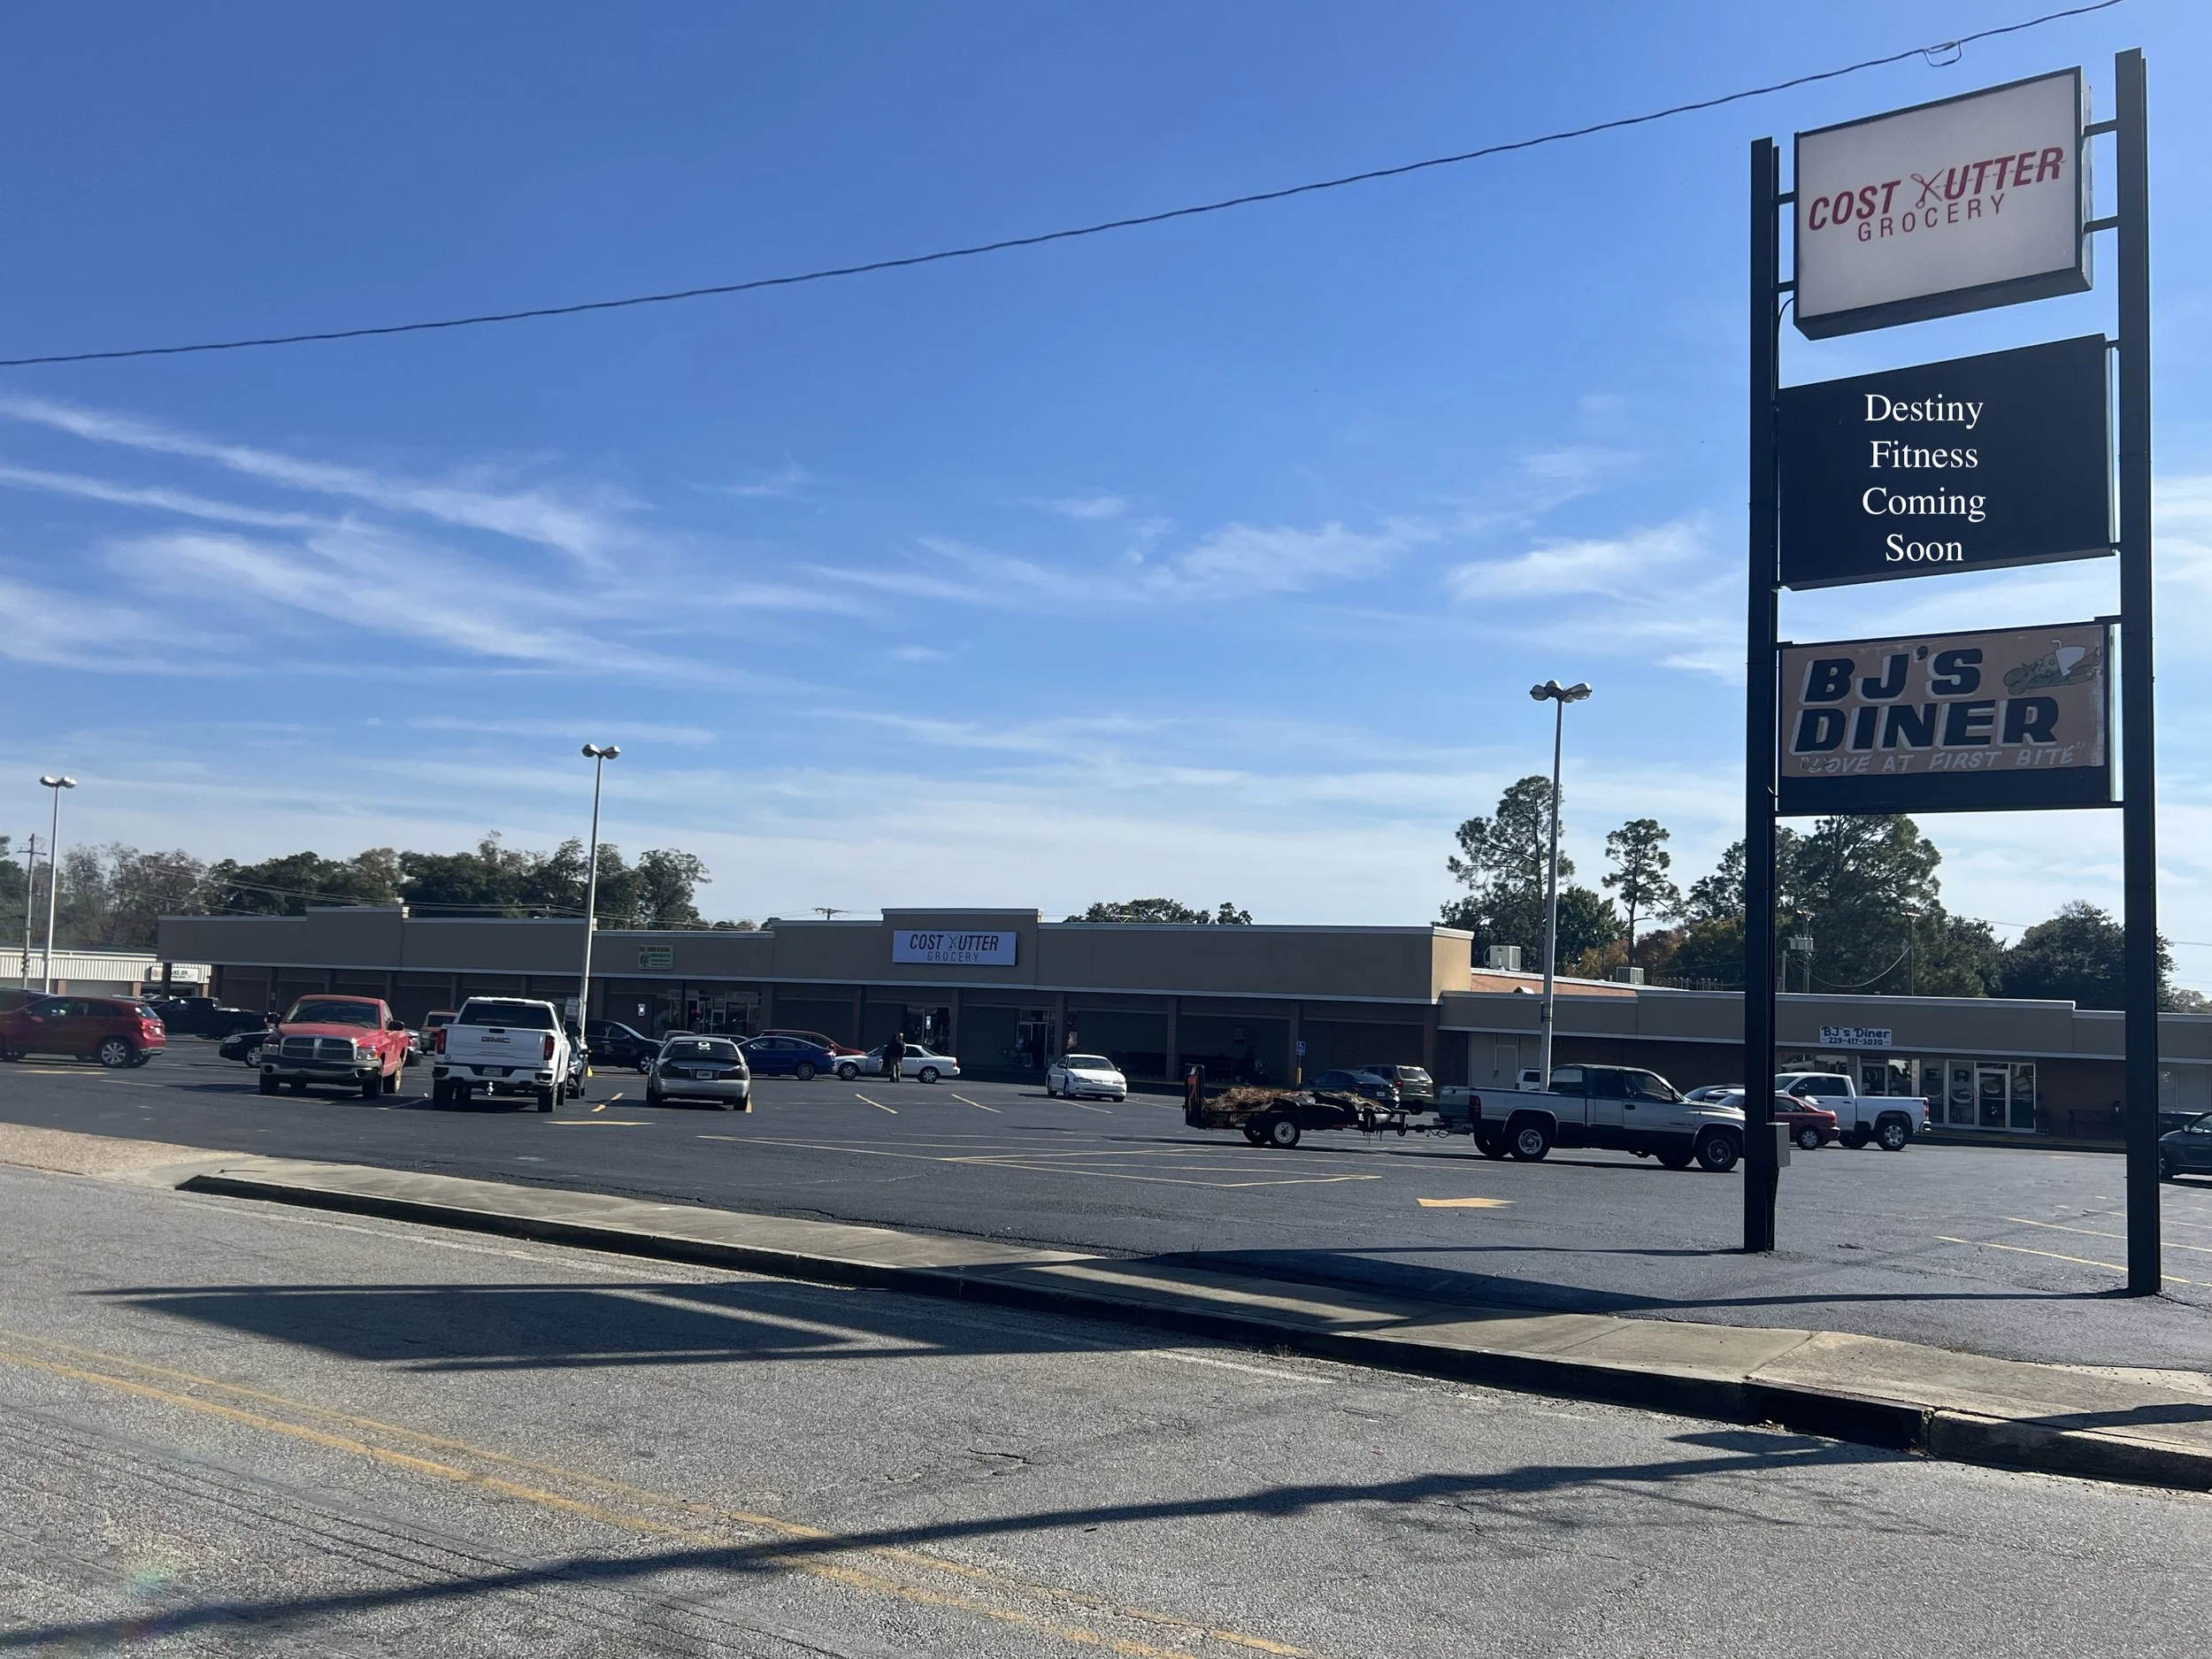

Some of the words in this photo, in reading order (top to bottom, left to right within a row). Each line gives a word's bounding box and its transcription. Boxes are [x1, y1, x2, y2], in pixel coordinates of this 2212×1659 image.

[1809, 180, 1901, 230] COST
[1858, 194, 2005, 242] GROCERY
[1864, 393, 1985, 430] Destiny
[1870, 441, 1978, 469] Fitness
[1863, 487, 1986, 523] Coming
[1886, 534, 1963, 562] Soon
[1799, 646, 1983, 705] BJ'S
[1789, 696, 2059, 755] DINER
[1882, 755, 1915, 772] AT
[1928, 751, 2003, 771] FIRST
[910, 934, 943, 949] COST
[927, 951, 979, 962] GROCERY
[1854, 1028, 1890, 1038] Diner
